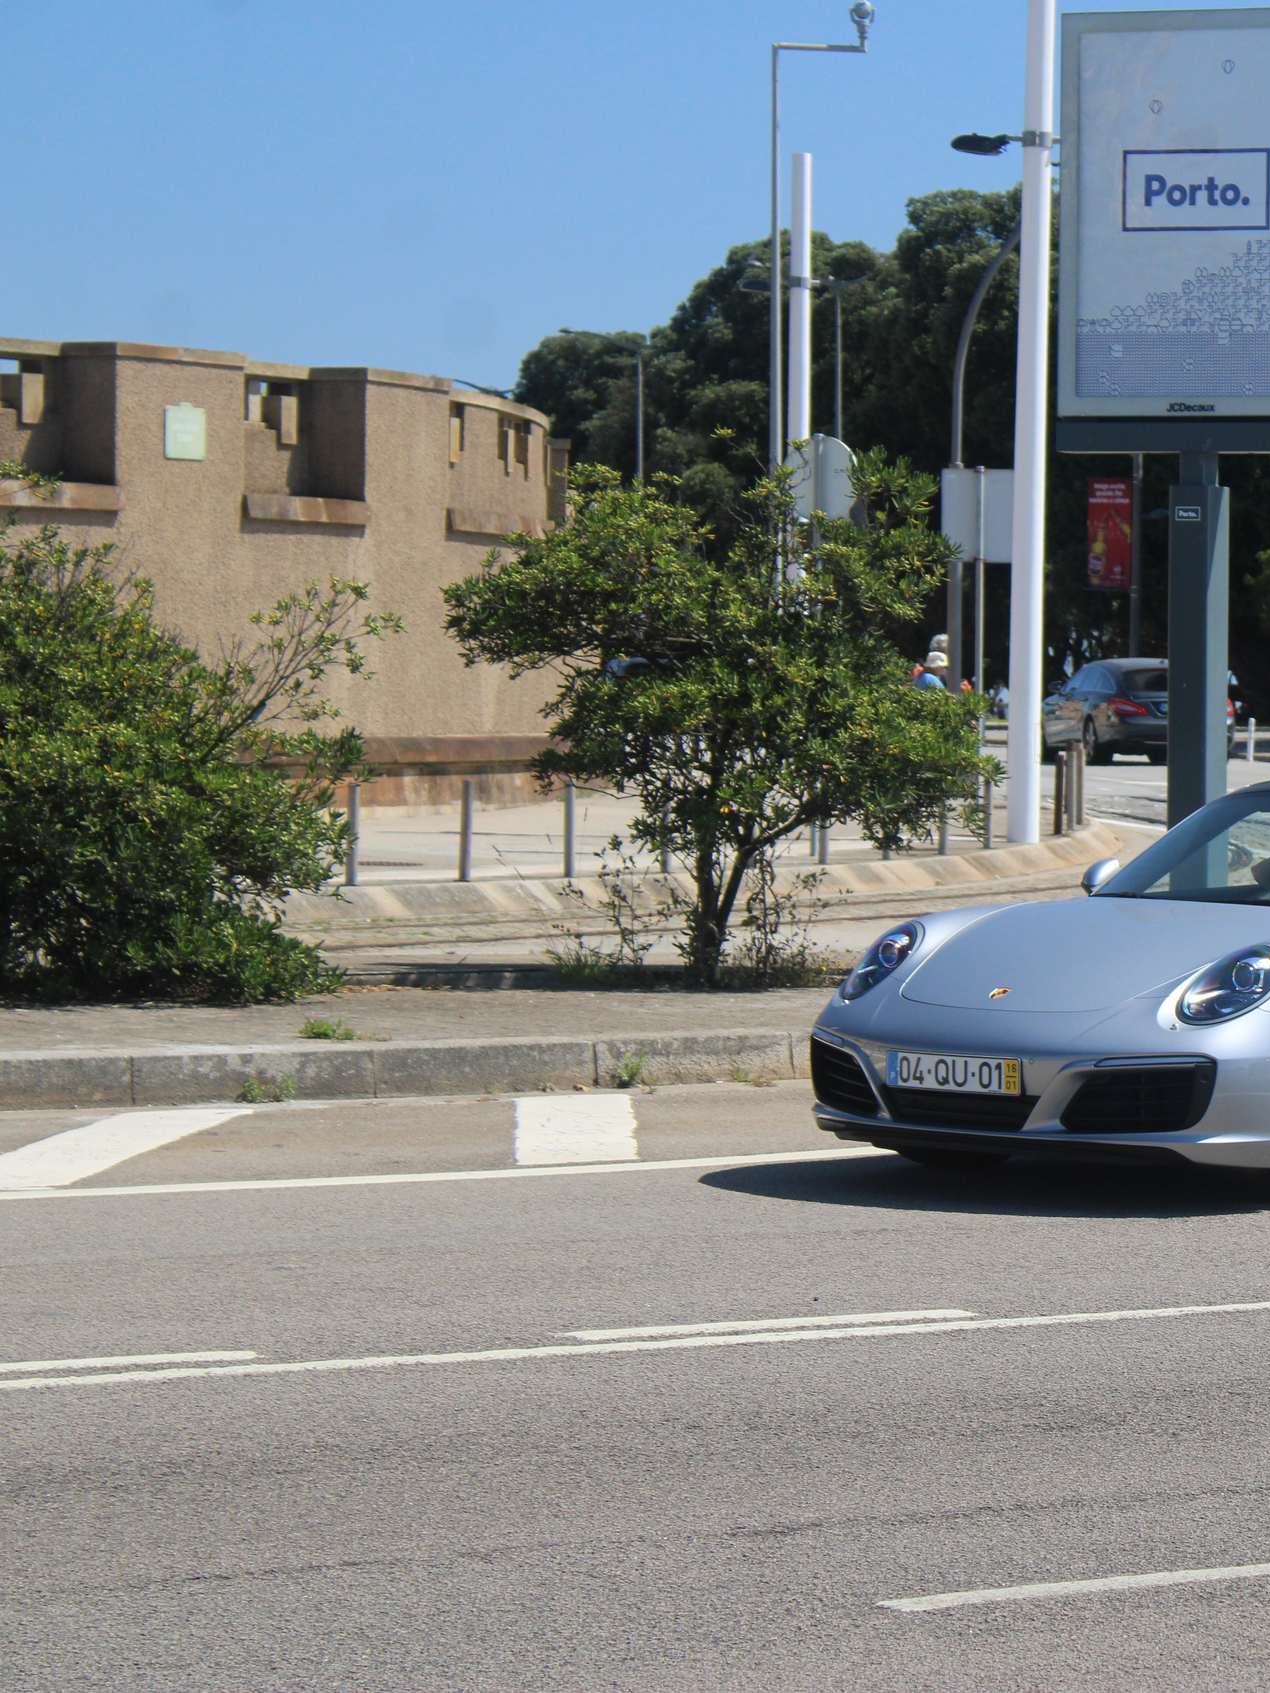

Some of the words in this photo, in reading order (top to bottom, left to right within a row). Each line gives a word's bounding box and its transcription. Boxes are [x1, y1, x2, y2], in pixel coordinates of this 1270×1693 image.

[1144, 173, 1250, 207] Porto.
[1166, 402, 1216, 412] JCDecaux
[1006, 1063, 1017, 1073] 16
[890, 1071, 896, 1079] P
[1005, 1080, 1017, 1090] 01
